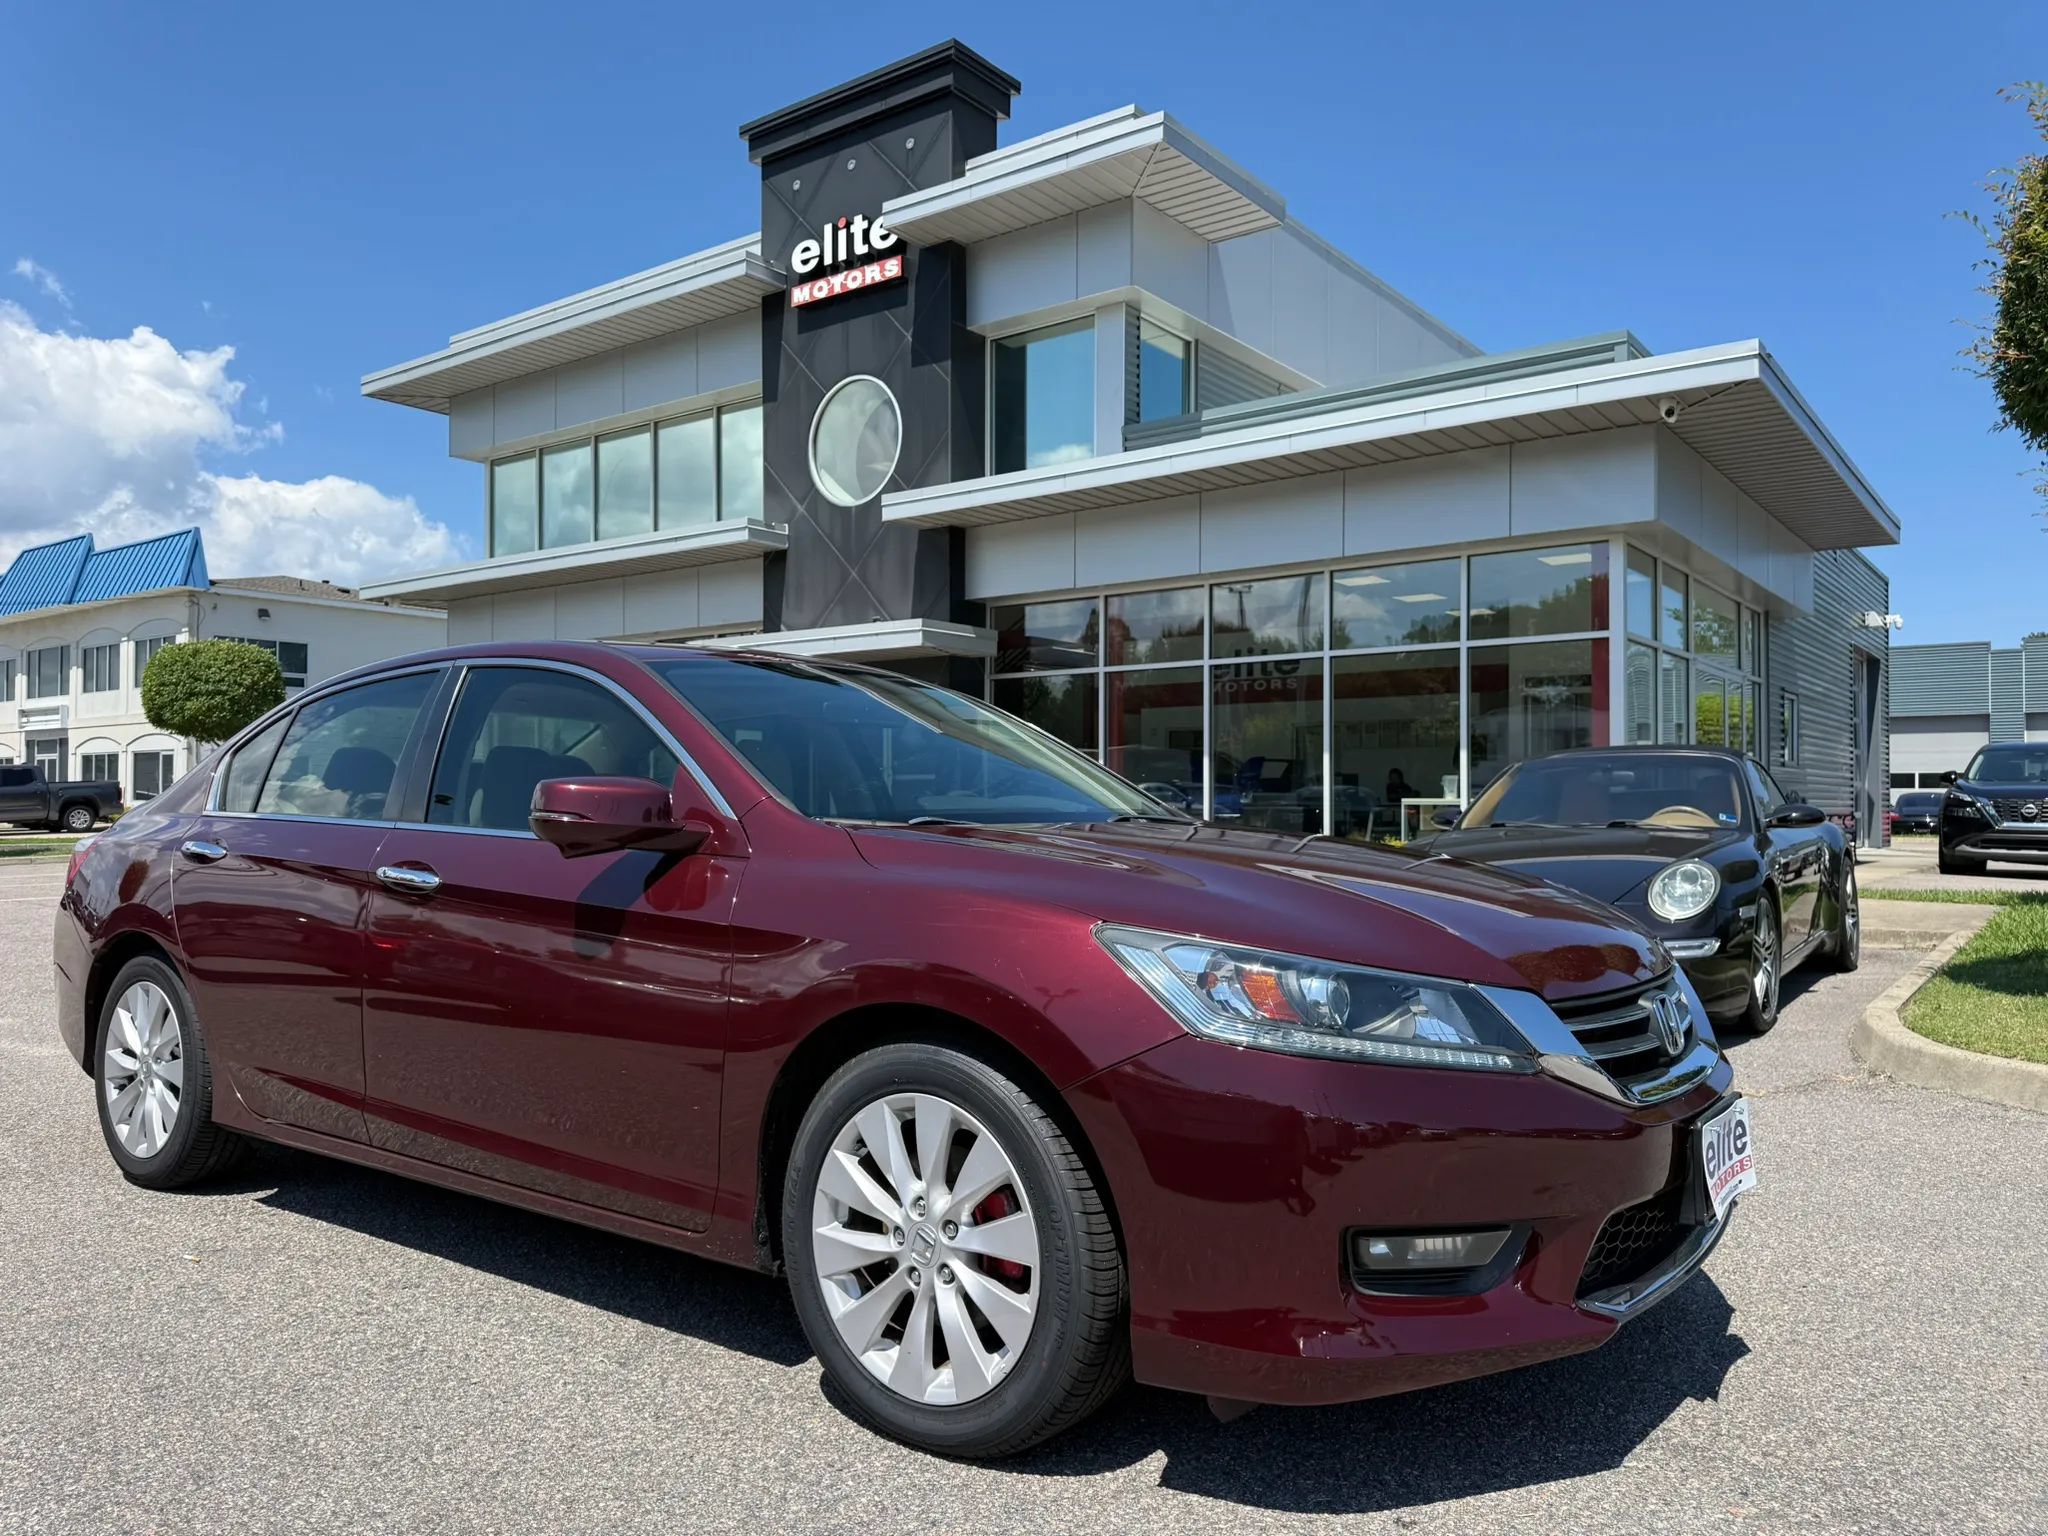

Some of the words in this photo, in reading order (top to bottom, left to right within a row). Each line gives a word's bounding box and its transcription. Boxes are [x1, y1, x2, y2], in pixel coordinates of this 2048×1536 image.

[791, 214, 899, 274] elite
[793, 258, 900, 304] MOTORS
[1705, 1119, 1748, 1180] elite
